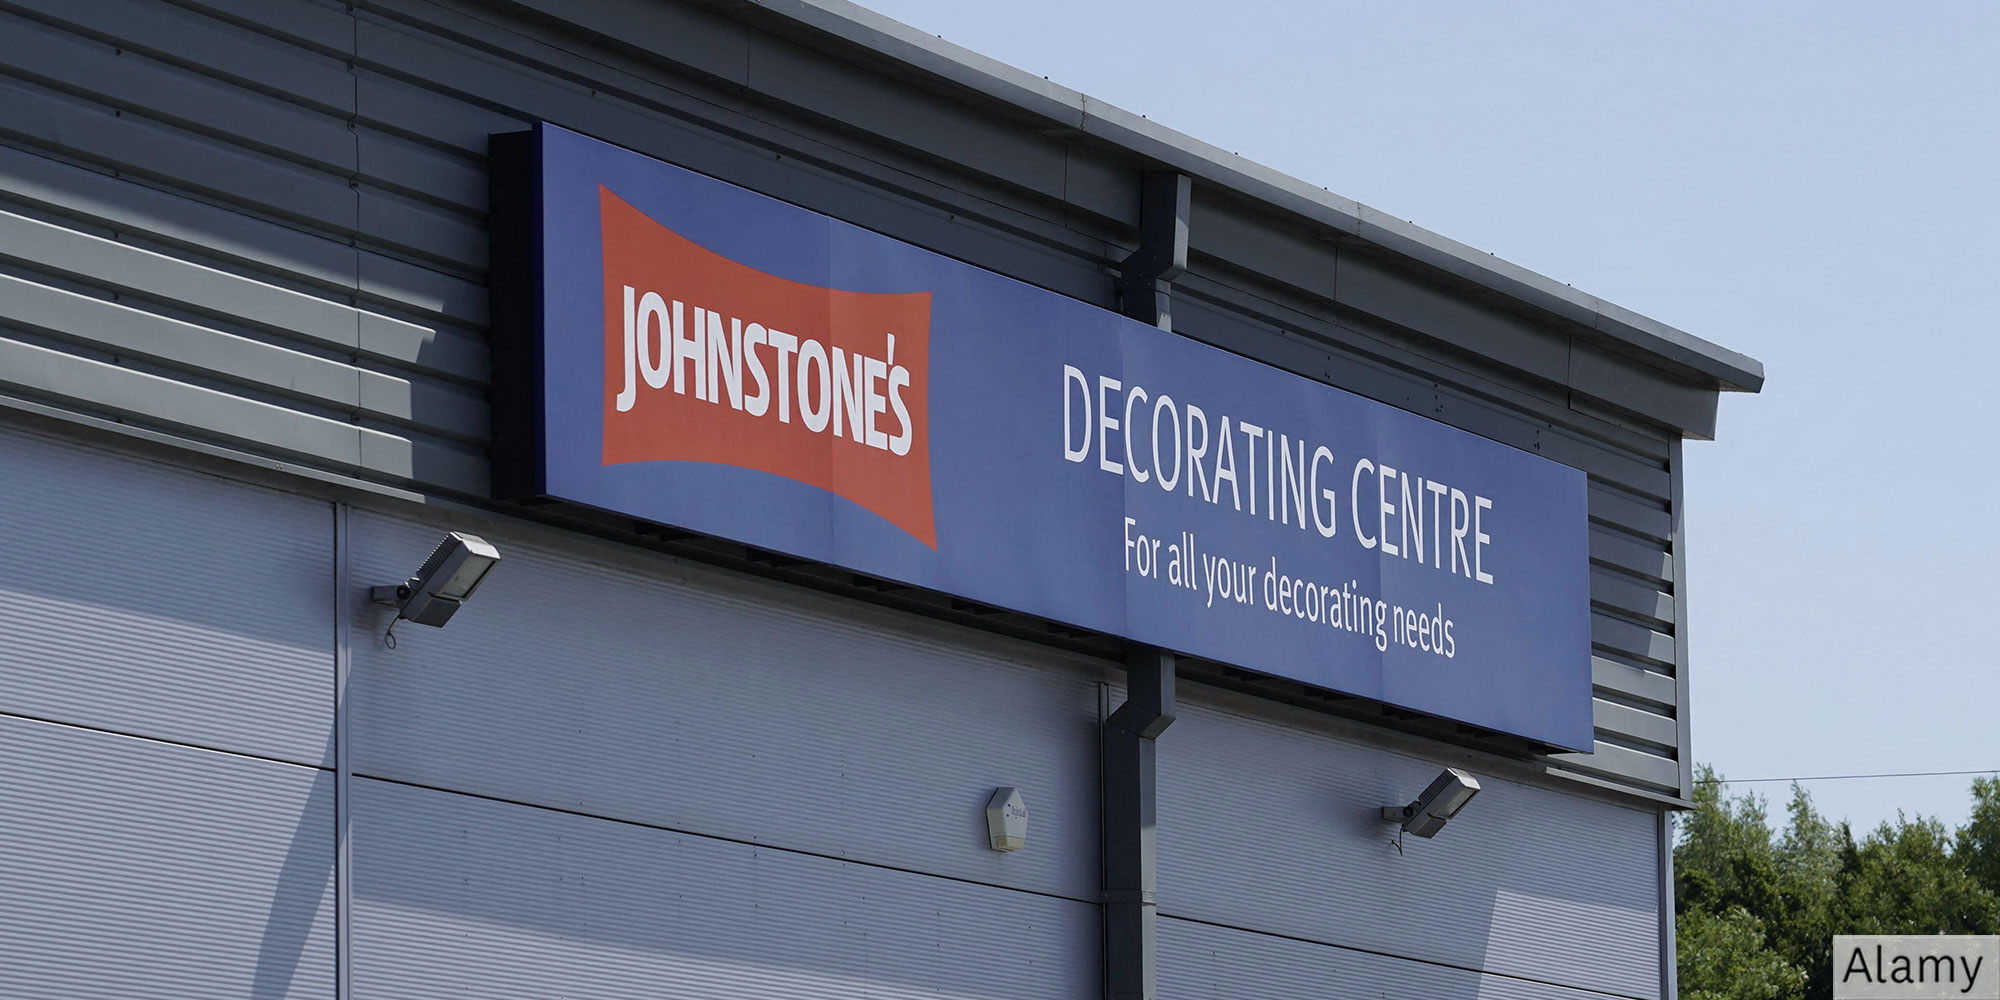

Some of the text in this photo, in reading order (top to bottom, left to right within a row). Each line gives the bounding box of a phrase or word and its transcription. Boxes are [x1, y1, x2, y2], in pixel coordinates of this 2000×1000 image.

[616, 284, 914, 457] JOHNSTONE'S
[1062, 364, 1495, 586] DECORATING CENTRE
[1124, 516, 1456, 660] For all your decorating needs
